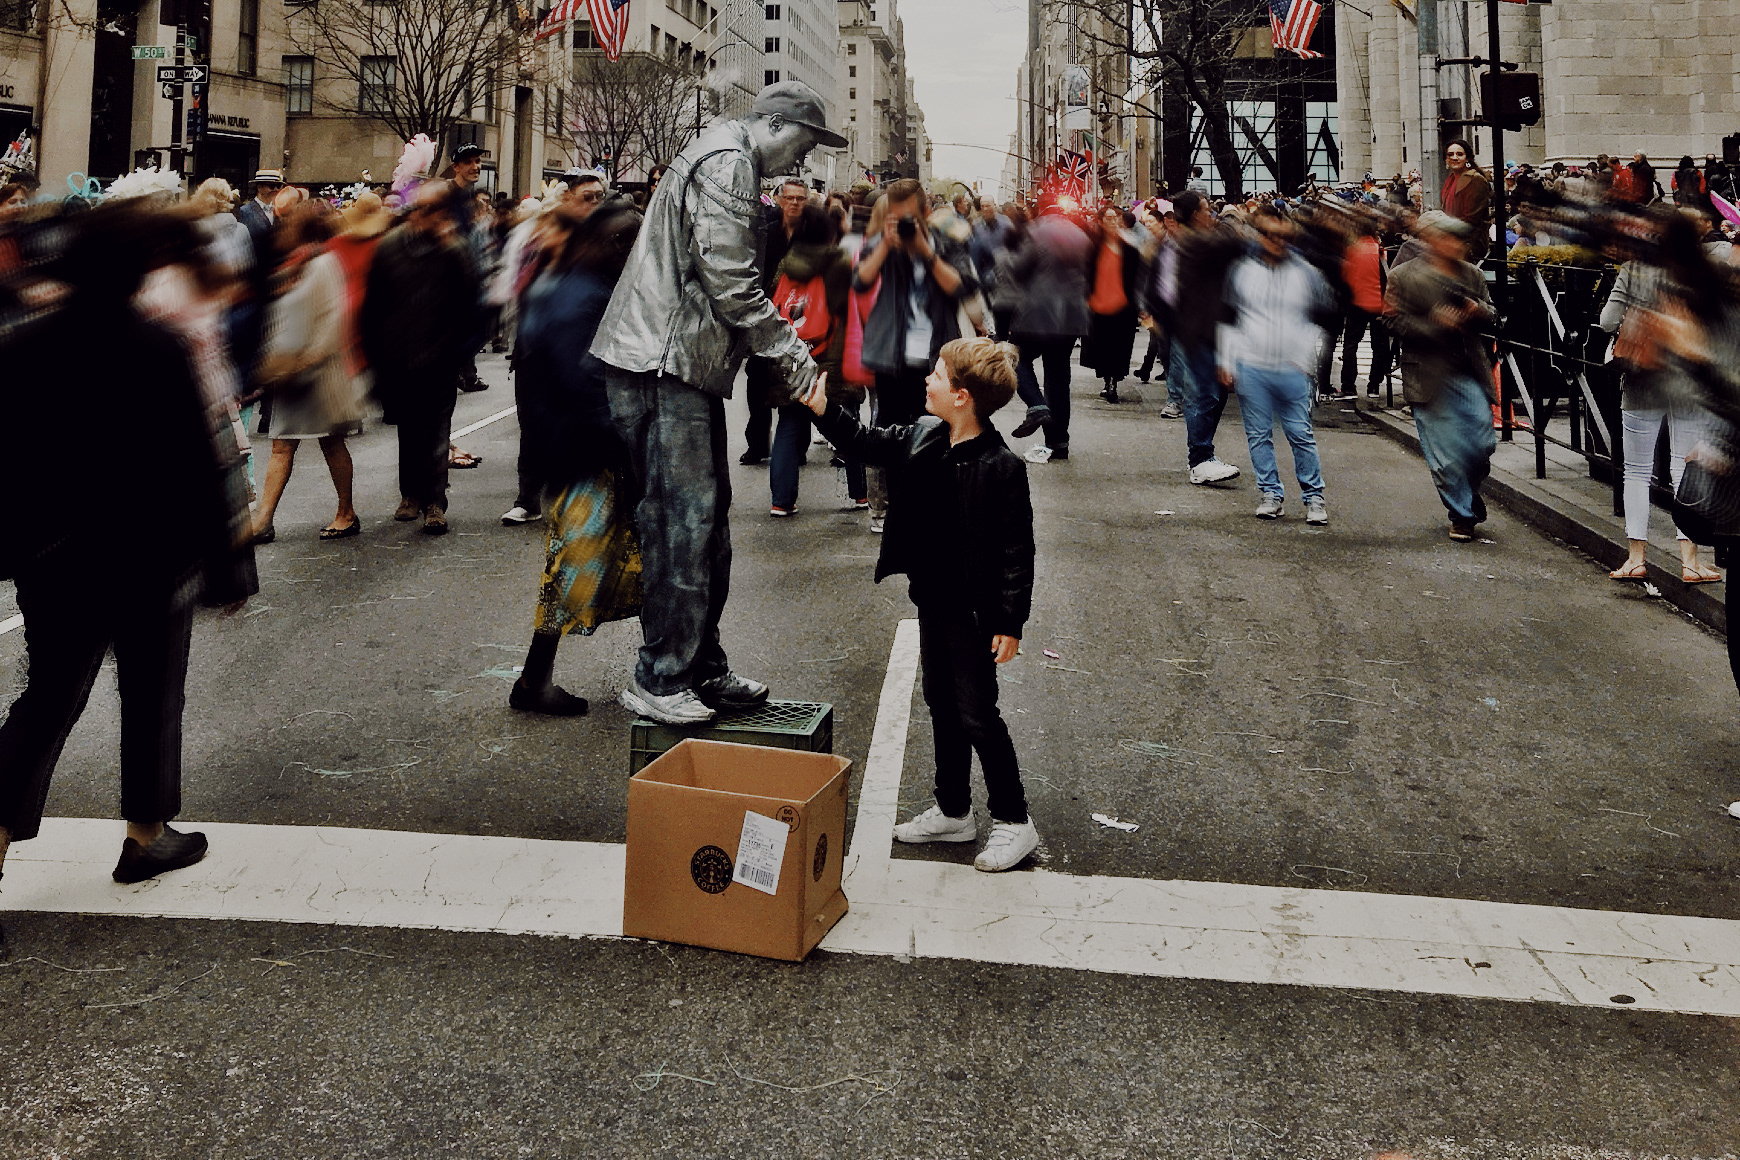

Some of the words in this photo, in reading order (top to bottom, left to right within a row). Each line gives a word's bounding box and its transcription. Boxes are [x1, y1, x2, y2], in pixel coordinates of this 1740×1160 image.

[133, 48, 141, 57] W
[144, 48, 157, 57] 50
[184, 70, 199, 78] WAY
[208, 114, 226, 125] ANANA
[694, 848, 731, 870] STARBUCKS
[697, 877, 725, 892] COFFEE
